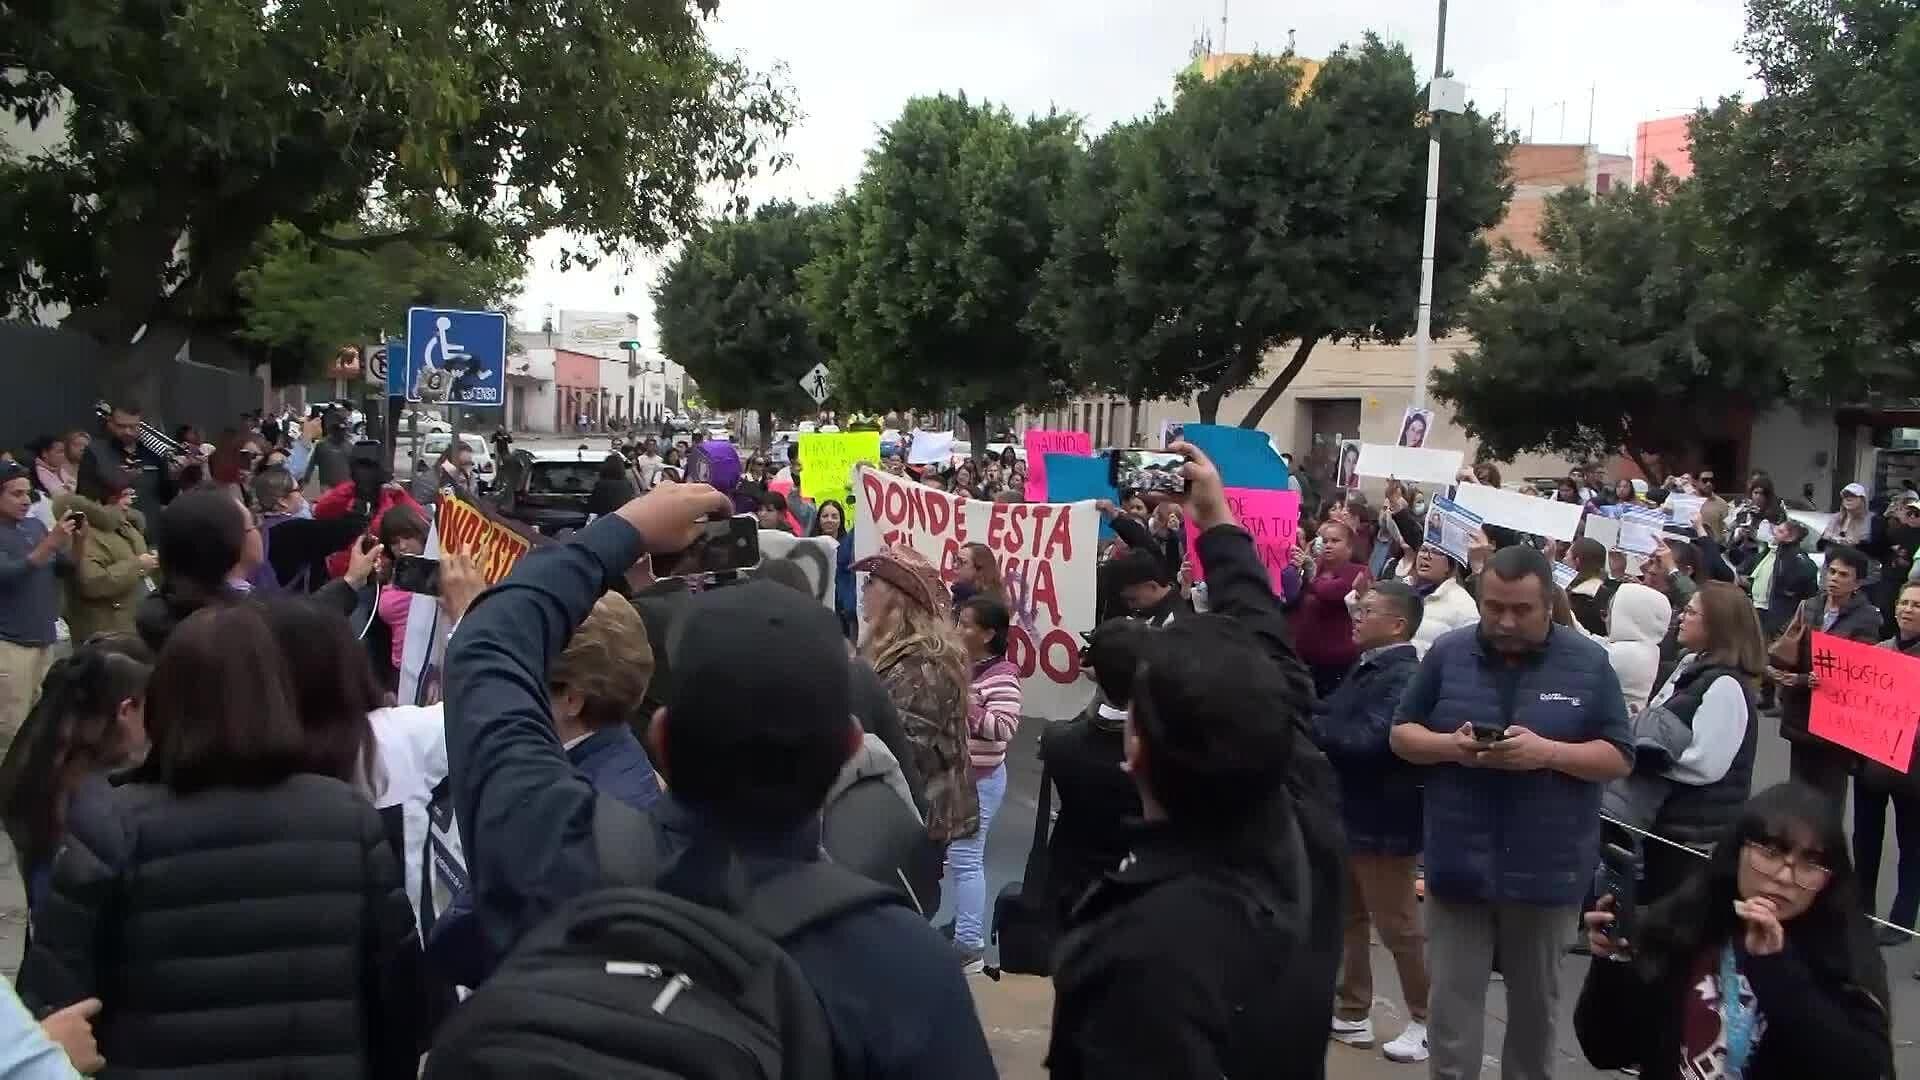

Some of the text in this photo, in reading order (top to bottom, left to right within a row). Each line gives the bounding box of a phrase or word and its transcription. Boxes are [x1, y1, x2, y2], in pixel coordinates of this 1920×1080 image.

[861, 472, 1073, 562] DONDE ESTA
[1240, 516, 1293, 538] STA TU
